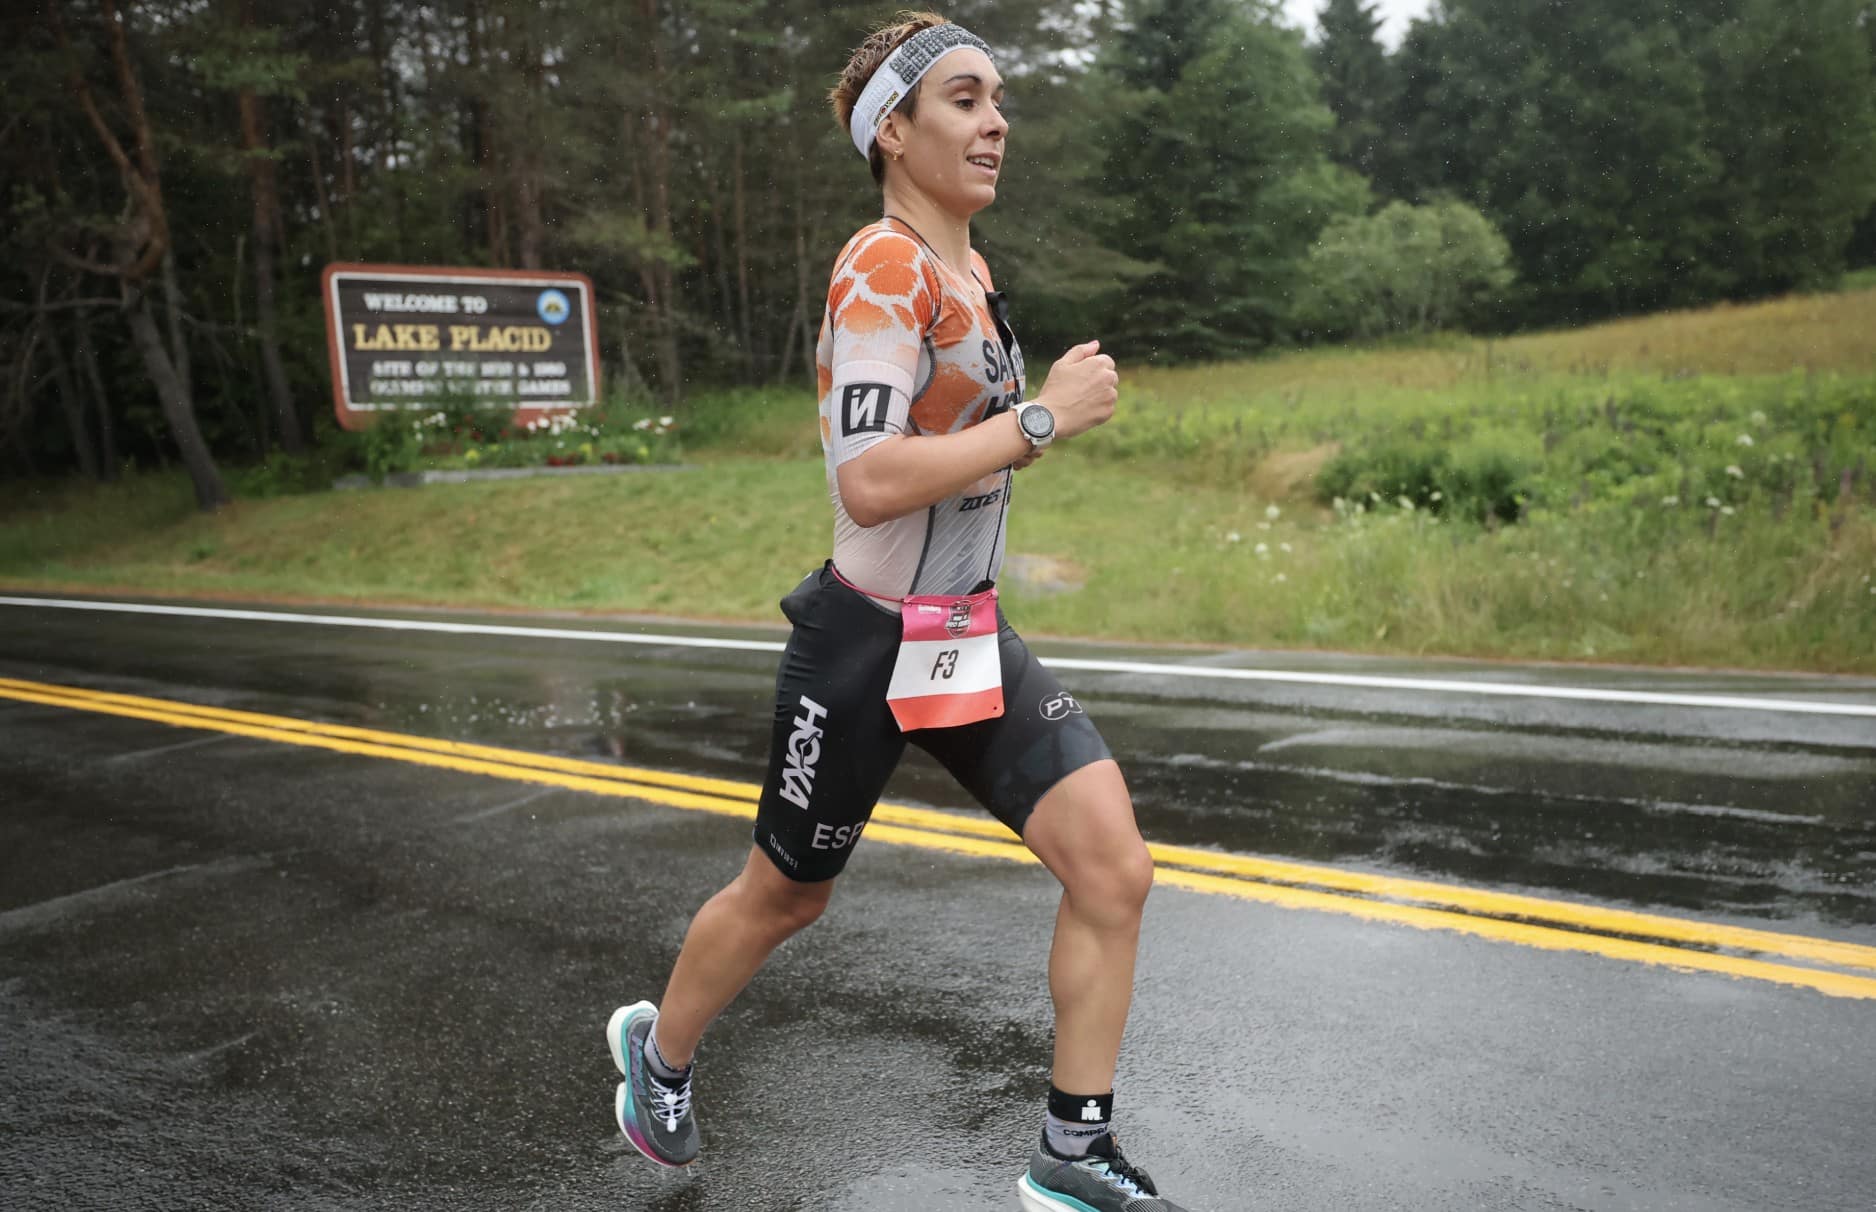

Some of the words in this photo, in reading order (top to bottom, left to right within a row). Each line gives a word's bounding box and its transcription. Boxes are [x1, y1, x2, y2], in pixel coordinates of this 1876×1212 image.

[363, 292, 458, 314] WELCOME
[460, 296, 488, 314] TO
[353, 323, 441, 351] LAKE
[450, 325, 553, 352] PLACID
[930, 648, 959, 681] F3
[779, 695, 828, 811] HOKA
